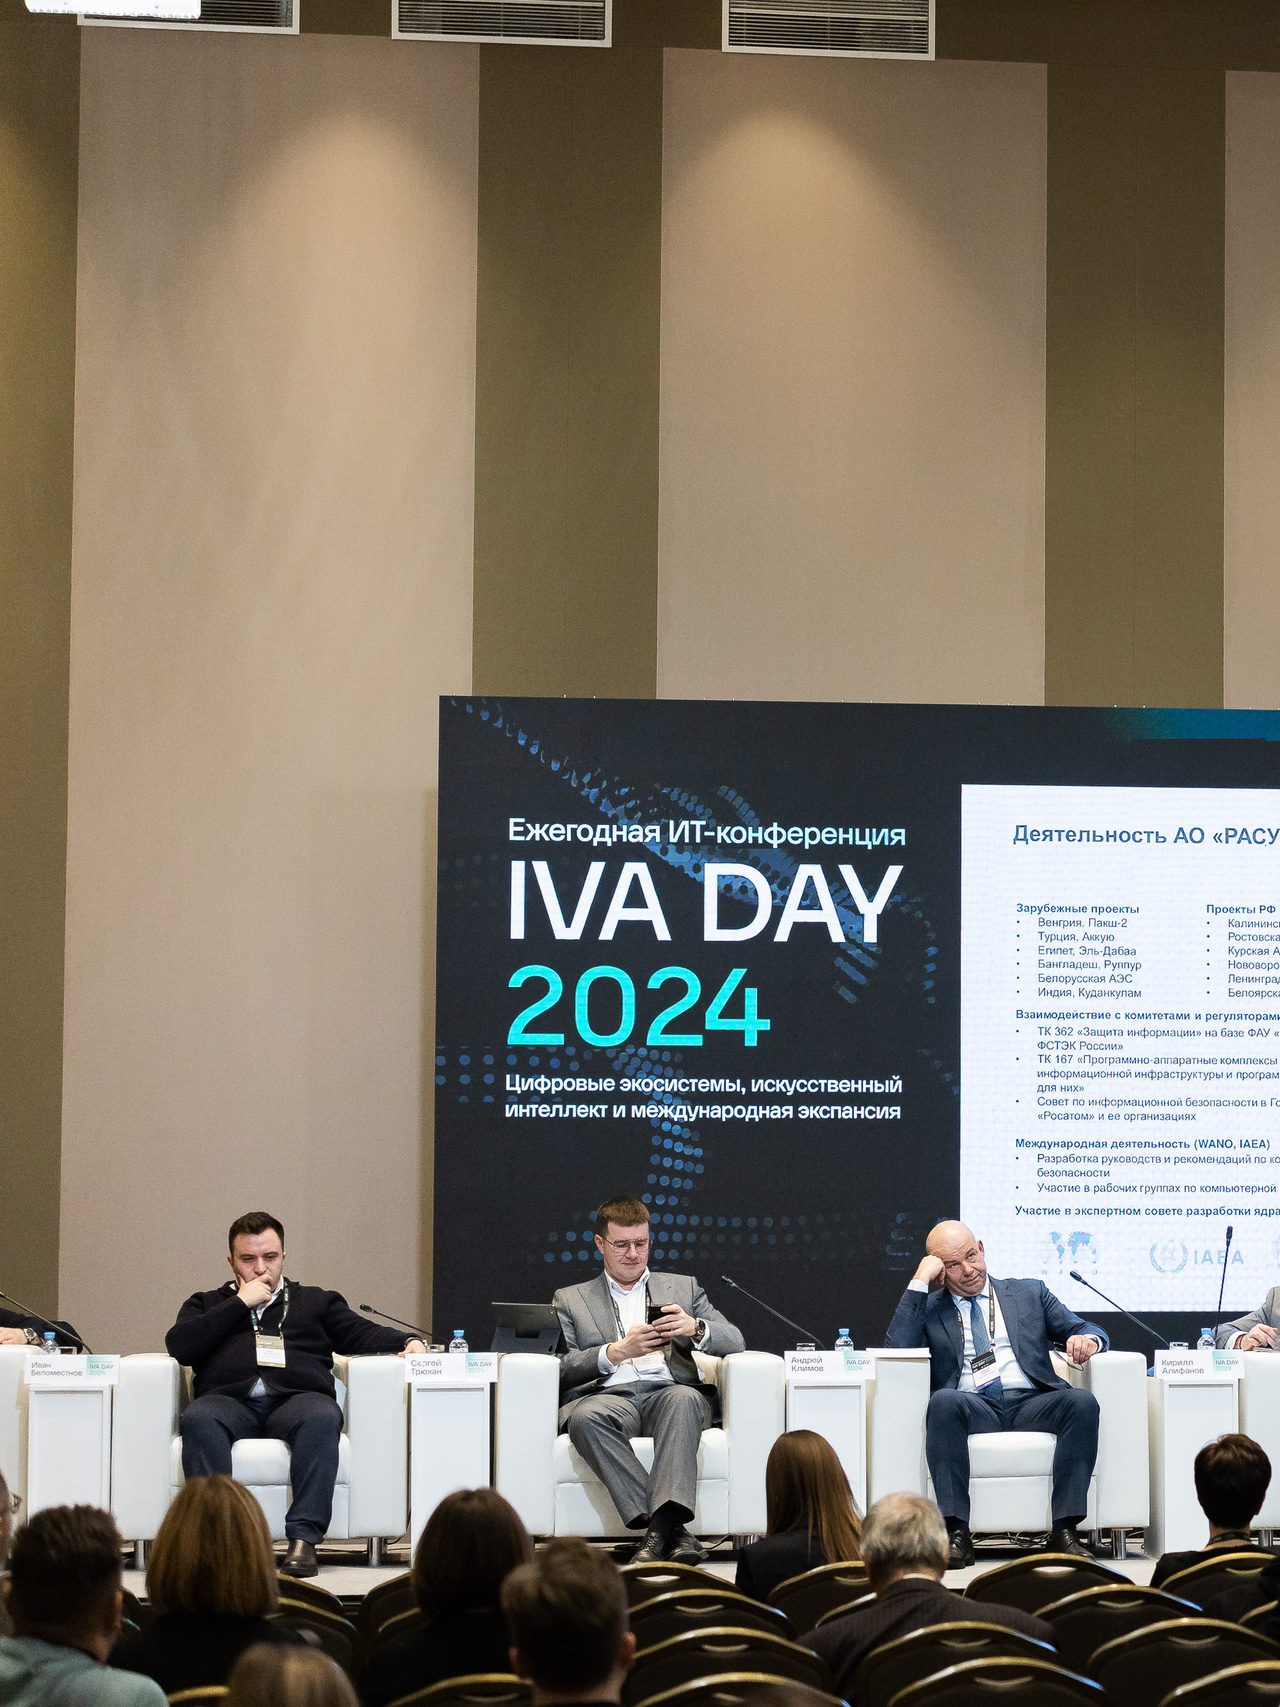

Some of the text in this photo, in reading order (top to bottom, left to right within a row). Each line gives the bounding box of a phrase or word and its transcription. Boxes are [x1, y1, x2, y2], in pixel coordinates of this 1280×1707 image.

[508, 818, 906, 849] Ежегодная ИТ-конференция
[1013, 826, 1166, 845] Деятельность
[1174, 827, 1204, 844] АО
[510, 860, 904, 943] IVA DAY
[1017, 903, 1139, 917] Зарубежные проекты
[1207, 905, 1275, 916] Проекты РФ
[1039, 917, 1127, 930] Венгрия, Пакш-2
[1038, 931, 1114, 944] Турция, Аккую
[1038, 946, 1136, 959] Египет, Эль-Дабаа
[1228, 946, 1269, 958] Курская
[1038, 959, 1141, 972] Бангладеш, Руппур
[1038, 973, 1132, 986] Белорусская АЭС
[1038, 988, 1141, 1000] Индия, Куданкулам
[507, 965, 771, 1047] 2024
[1016, 1010, 1111, 1021] Взаимодействие
[1115, 1012, 1120, 1020] с
[1125, 1012, 1190, 1020] комитетами
[1038, 1027, 1051, 1036] ТК
[1055, 1027, 1073, 1037] 362
[1078, 1027, 1123, 1038] «Защита
[1128, 1027, 1201, 1039] информации»
[1221, 1028, 1244, 1038] базе
[1248, 1029, 1270, 1038] ФАУ
[1038, 1041, 1123, 1051] ФСТЭК России»
[1038, 1054, 1051, 1064] ТК
[1056, 1055, 1073, 1064] 167
[1078, 1055, 1217, 1067] «Программно-аппаратные
[1220, 1058, 1277, 1066] комплексы
[1038, 1069, 1132, 1081] информационной
[1135, 1069, 1223, 1081] инфраструктуры
[506, 1074, 902, 1098] Цифровые экосистемы, искусственный
[1037, 1085, 1084, 1094] для них»
[1037, 1097, 1069, 1107] Совет
[1073, 1099, 1085, 1107] по
[1089, 1097, 1182, 1109] информационной
[1186, 1098, 1257, 1108] безопасности
[1261, 1100, 1266, 1108] в
[505, 1100, 900, 1122] интеллект и международная экспансия
[1038, 1111, 1094, 1121] «Росатом»
[1108, 1113, 1120, 1121] ее
[1124, 1113, 1196, 1123] организациях
[1016, 1139, 1270, 1151] Международная деятельность (WANO, IAEA)
[1038, 1154, 1098, 1166] Разработка
[1102, 1156, 1161, 1166] руководств
[1164, 1156, 1170, 1164] и
[1174, 1154, 1251, 1166] рекомендаций
[1254, 1156, 1266, 1164] по
[1037, 1168, 1110, 1178] безопасности
[1037, 1183, 1080, 1193] Участие
[1084, 1185, 1090, 1193] в
[1094, 1183, 1137, 1195] рабочих
[1140, 1185, 1180, 1195] группах
[1200, 1184, 1276, 1195] компьютерной
[1015, 1206, 1060, 1216] Участие
[1065, 1208, 1071, 1216] в
[1075, 1208, 1140, 1218] экспертном
[1145, 1208, 1182, 1216] совете
[1187, 1206, 1250, 1218] разработки
[1254, 1208, 1280, 1218] ядра
[1194, 1250, 1244, 1265] IAEA
[791, 1356, 823, 1364] Андрей
[1161, 1359, 1194, 1367] Кирилл
[30, 1369, 83, 1377] Беломестнов
[411, 1368, 442, 1376] Трюхан
[1162, 1367, 1205, 1375] Алифанов
